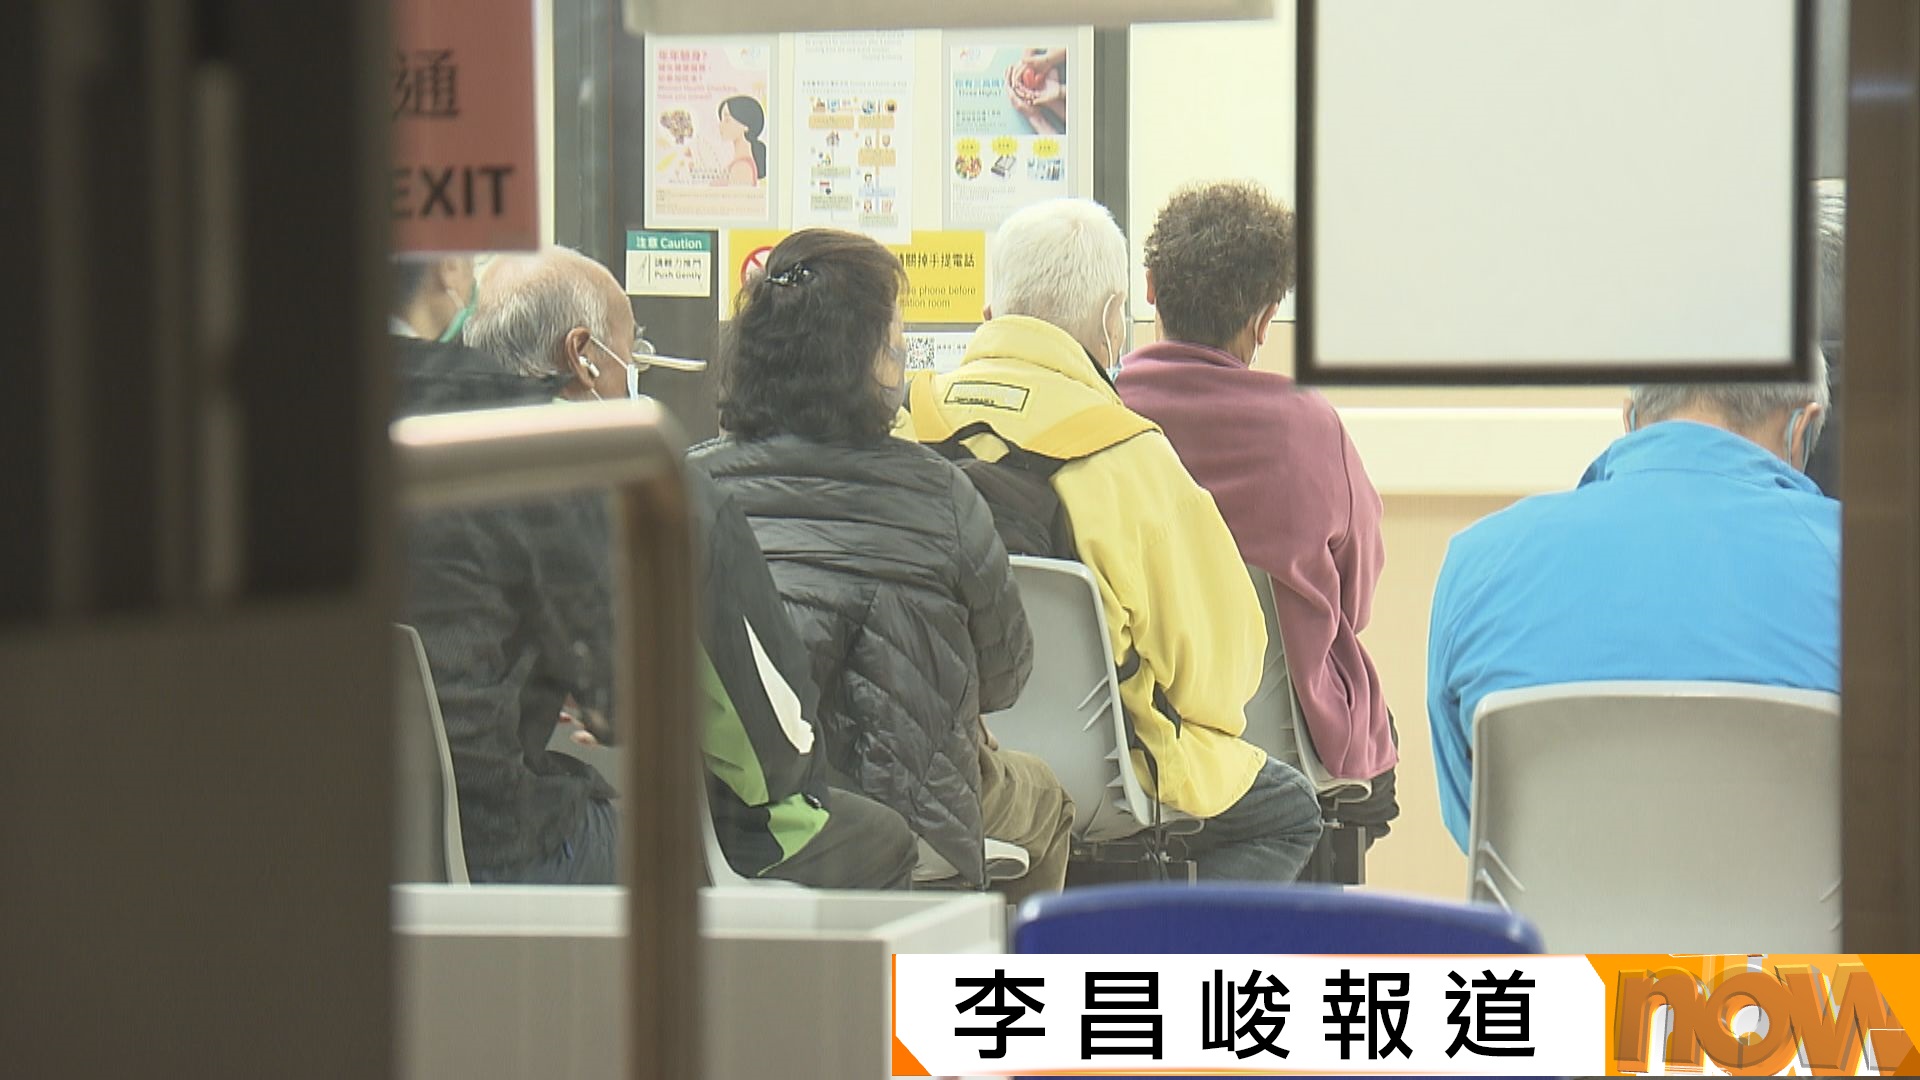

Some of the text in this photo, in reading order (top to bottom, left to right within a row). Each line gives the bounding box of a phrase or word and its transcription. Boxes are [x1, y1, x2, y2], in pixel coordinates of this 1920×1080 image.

[391, 165, 516, 220] EXIT
[660, 237, 703, 250] Caution
[655, 271, 701, 281] Push Gently
[919, 284, 946, 297] phone
[948, 284, 976, 296] before
[928, 298, 951, 308] room
